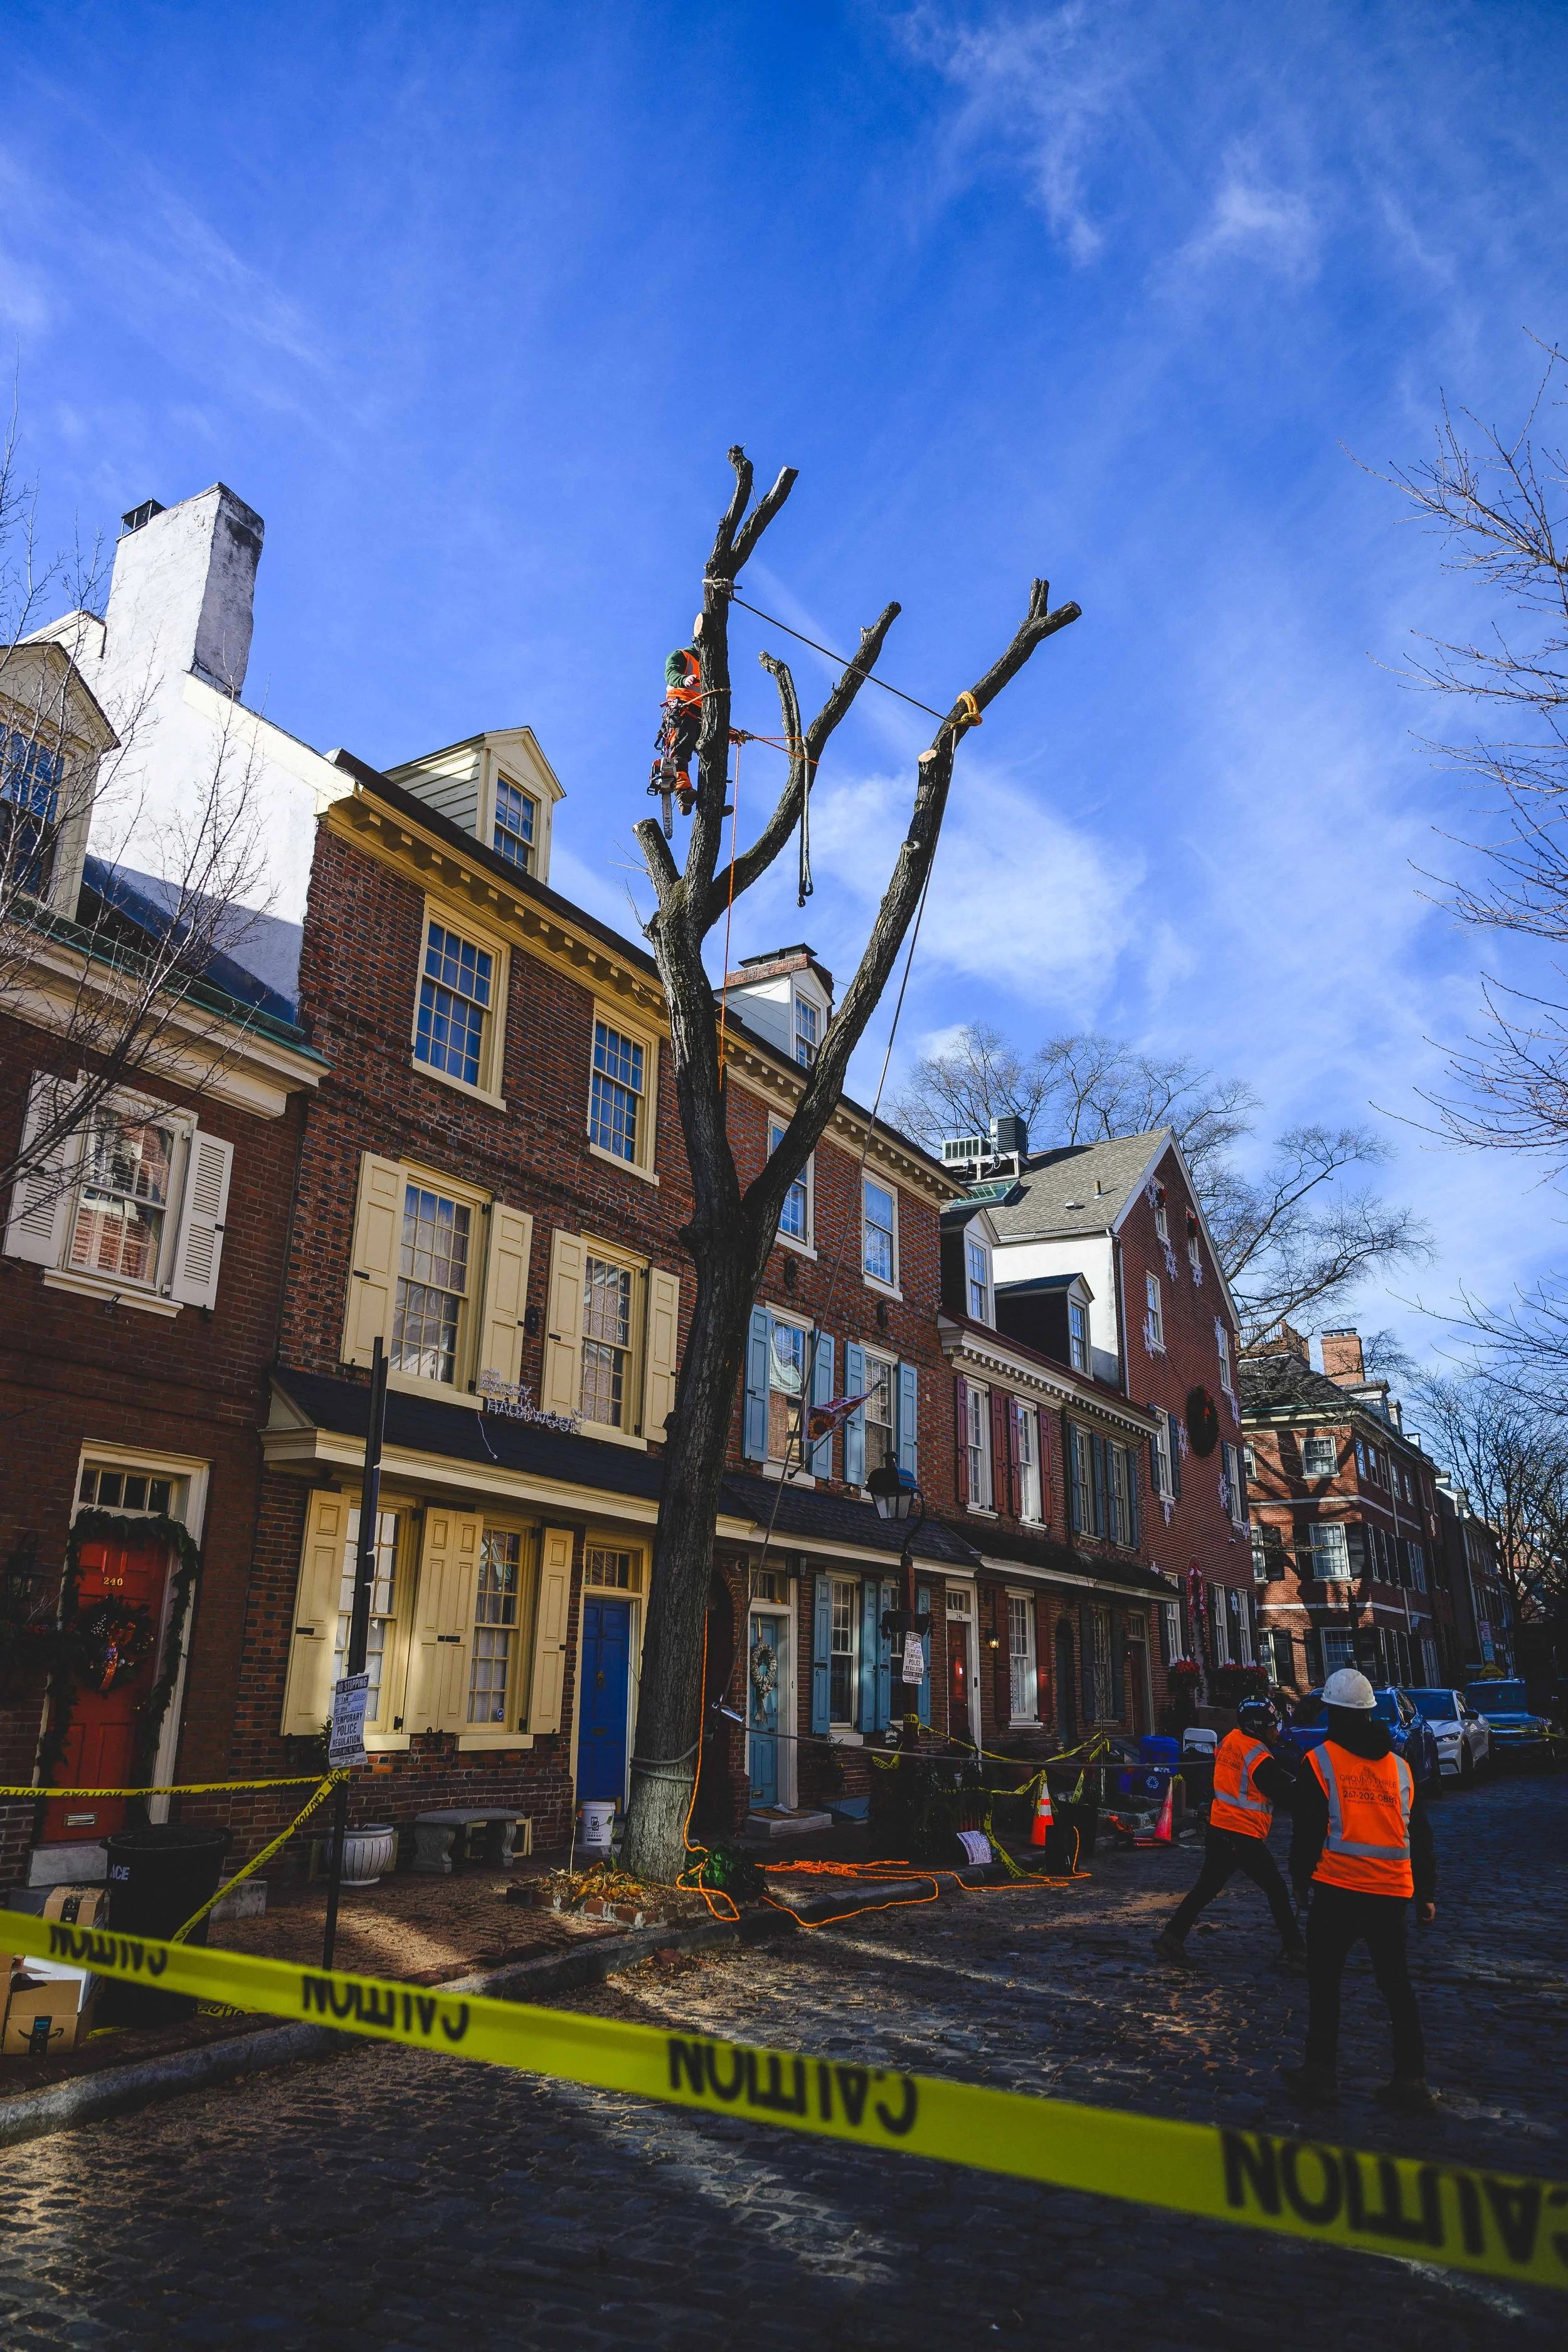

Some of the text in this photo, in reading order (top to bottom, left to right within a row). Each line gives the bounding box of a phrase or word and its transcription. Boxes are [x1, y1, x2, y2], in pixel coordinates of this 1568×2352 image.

[103, 1577, 124, 1586] 240
[908, 1658, 921, 1666] POLICE
[337, 1677, 368, 1693] NO STOPPING
[334, 1711, 363, 1727] TEMPORARY
[337, 1723, 357, 1737] POLICE
[332, 1735, 361, 1748] REGULATION
[1339, 1774, 1372, 1784] GROUND
[1374, 1778, 1397, 1789] THREE
[110, 1863, 130, 1880] ACE
[667, 2037, 919, 2136] CAUTION
